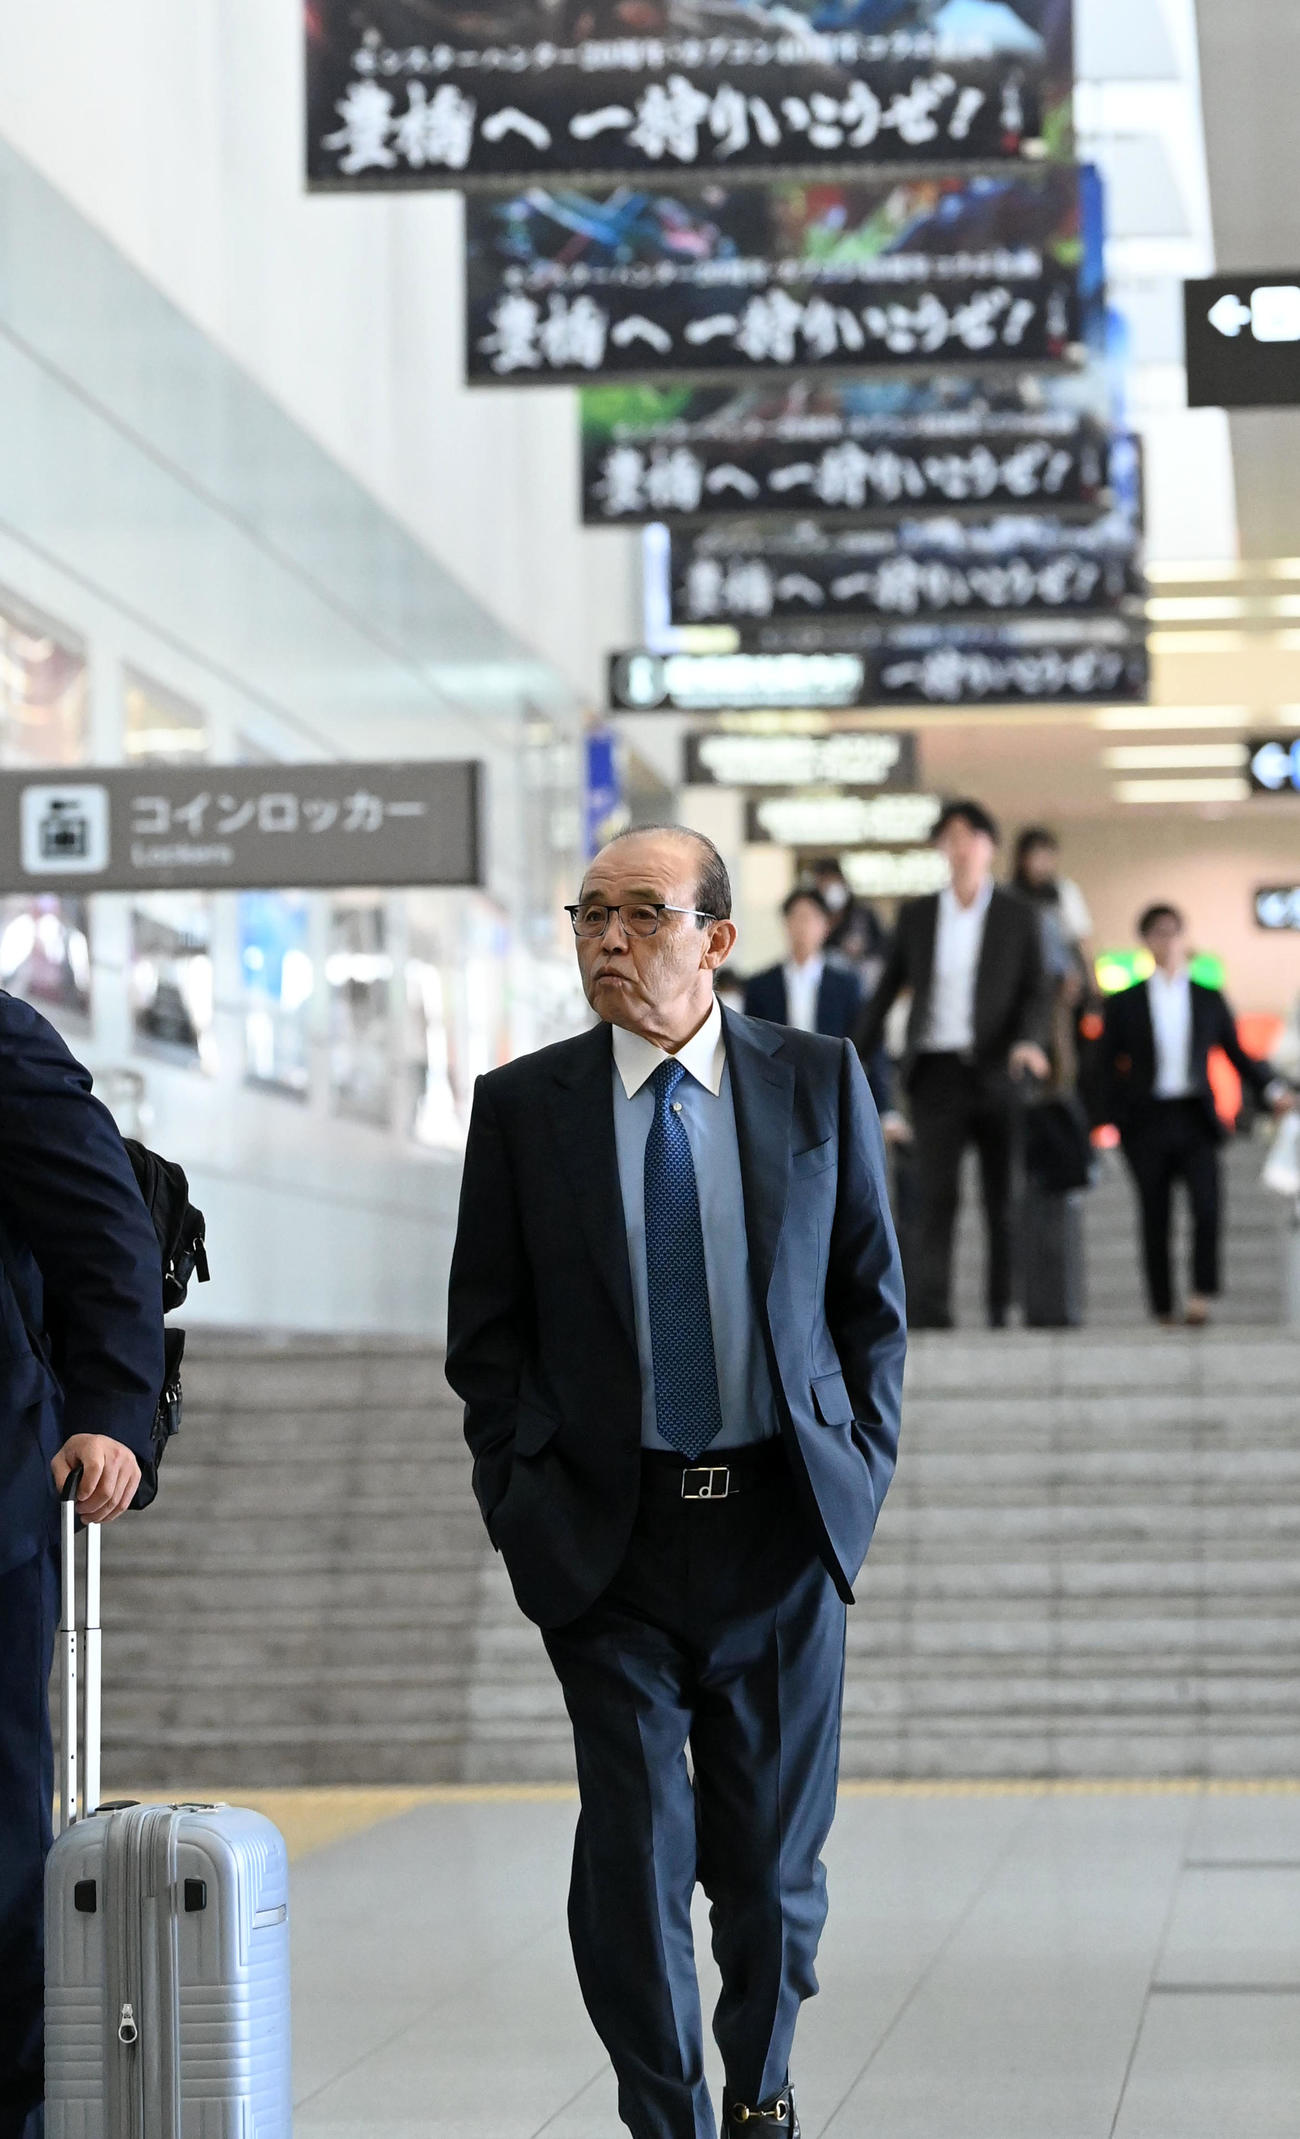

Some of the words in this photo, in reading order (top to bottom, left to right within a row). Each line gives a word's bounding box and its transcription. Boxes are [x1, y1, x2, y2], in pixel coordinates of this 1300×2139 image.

[131, 788, 425, 836] コインロッカー
